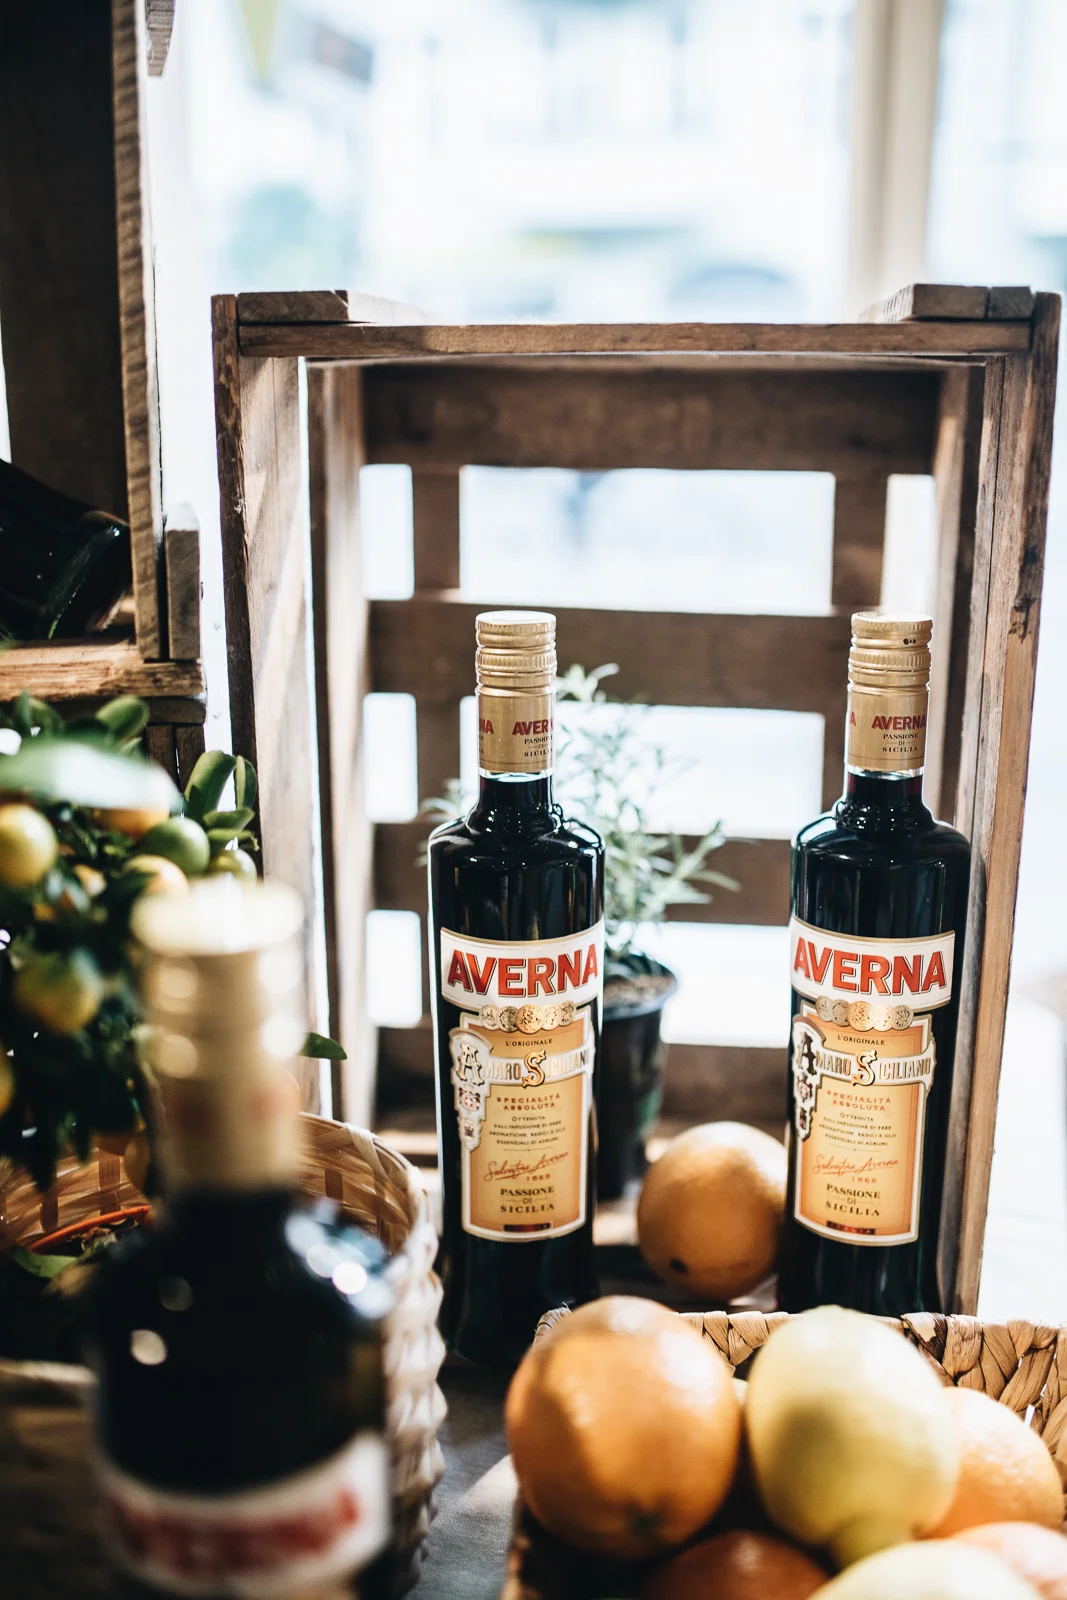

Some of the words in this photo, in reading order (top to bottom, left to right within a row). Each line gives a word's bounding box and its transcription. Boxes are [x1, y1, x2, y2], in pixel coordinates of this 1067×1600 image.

[871, 713, 926, 730] AVERNA
[447, 943, 599, 998] AVERNA
[793, 936, 948, 997] AVERNA
[505, 1038, 553, 1047] L'ORIGINALE
[837, 1034, 885, 1046] L'ORIGINALE
[850, 1049, 932, 1086] SICILIANO
[503, 1102, 556, 1111] ASSOLUTA
[832, 1099, 886, 1112] ASSOLUTA
[500, 1185, 555, 1197] PASSIONE
[826, 1183, 881, 1199] PASSIONE
[847, 1197, 857, 1205] DI
[499, 1203, 555, 1214] SICILIA
[824, 1200, 880, 1217] SICILIA
